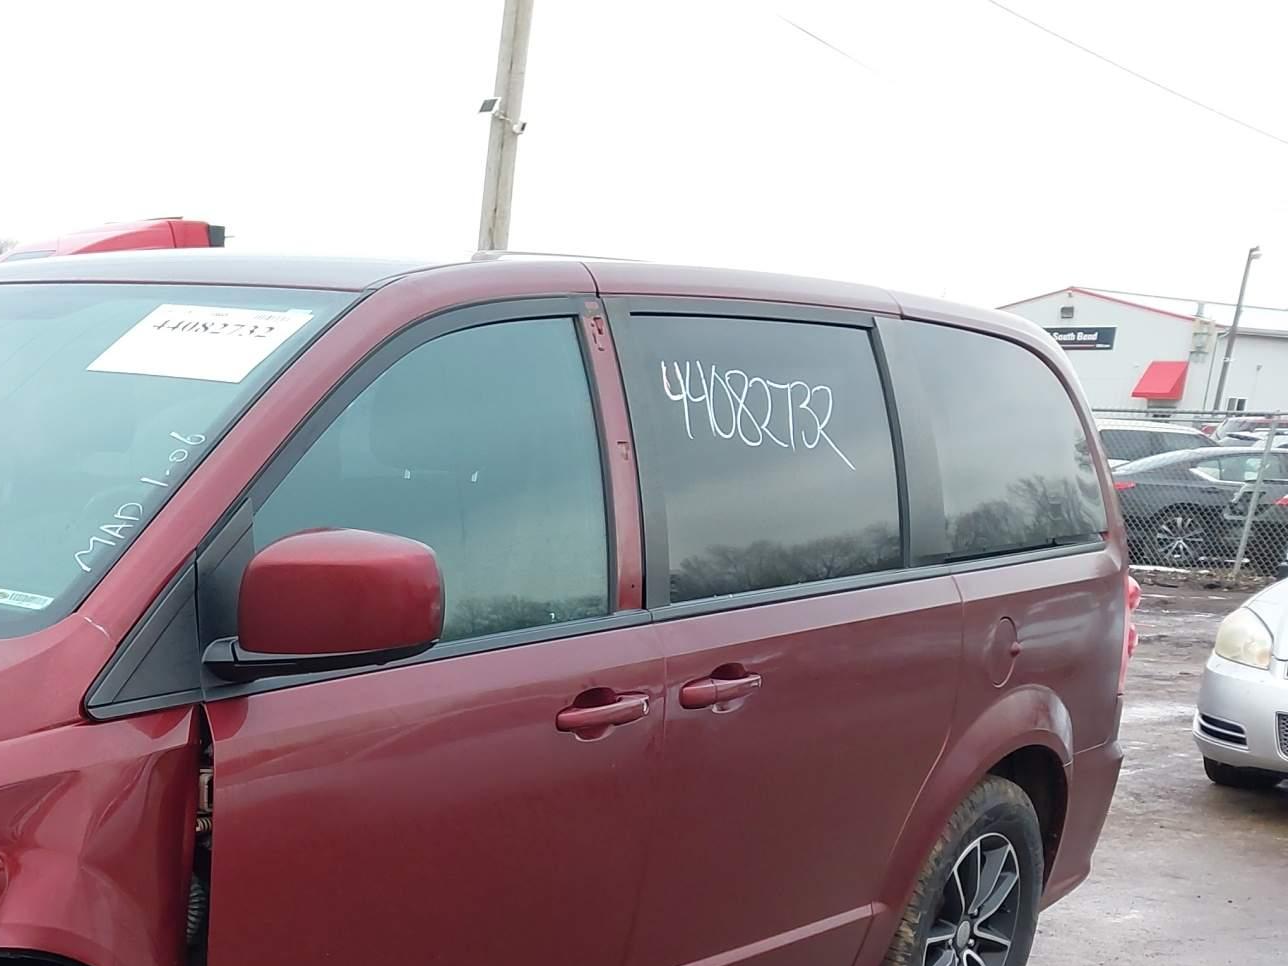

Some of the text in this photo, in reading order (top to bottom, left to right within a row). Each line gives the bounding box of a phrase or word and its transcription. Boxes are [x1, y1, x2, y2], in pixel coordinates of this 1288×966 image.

[152, 319, 275, 338] 44082732
[1053, 331, 1098, 341] South Bend
[661, 361, 856, 471] 44082732
[74, 502, 144, 572] MAD
